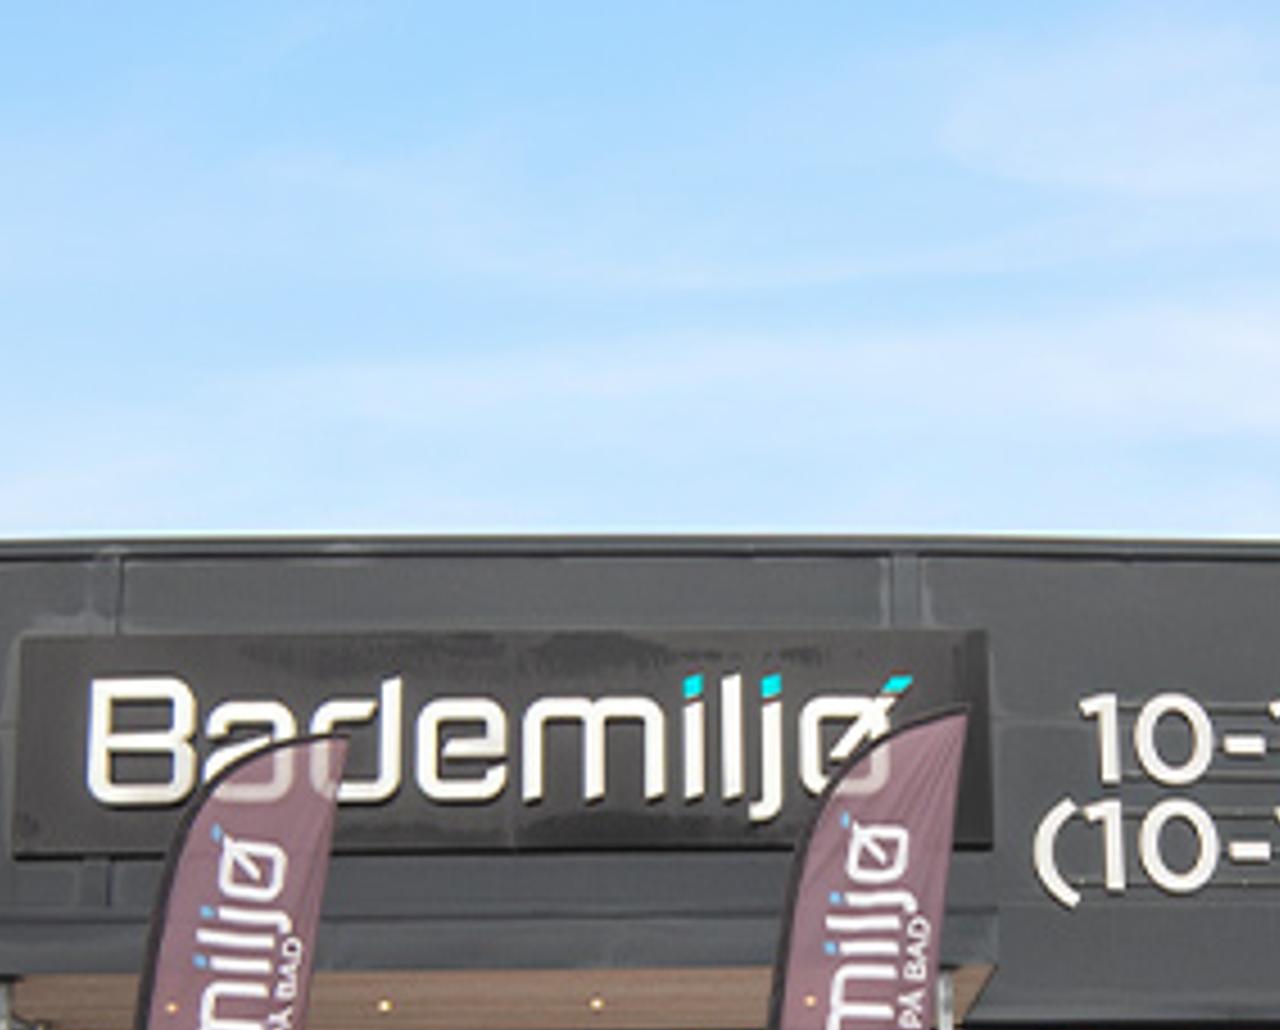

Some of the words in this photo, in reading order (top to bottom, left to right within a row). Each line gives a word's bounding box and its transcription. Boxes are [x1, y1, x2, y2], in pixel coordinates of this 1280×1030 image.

[86, 672, 914, 822] Bademiljø
[274, 936, 303, 999] BAD
[903, 915, 932, 981] BAD
[898, 986, 927, 1030] PÅ
